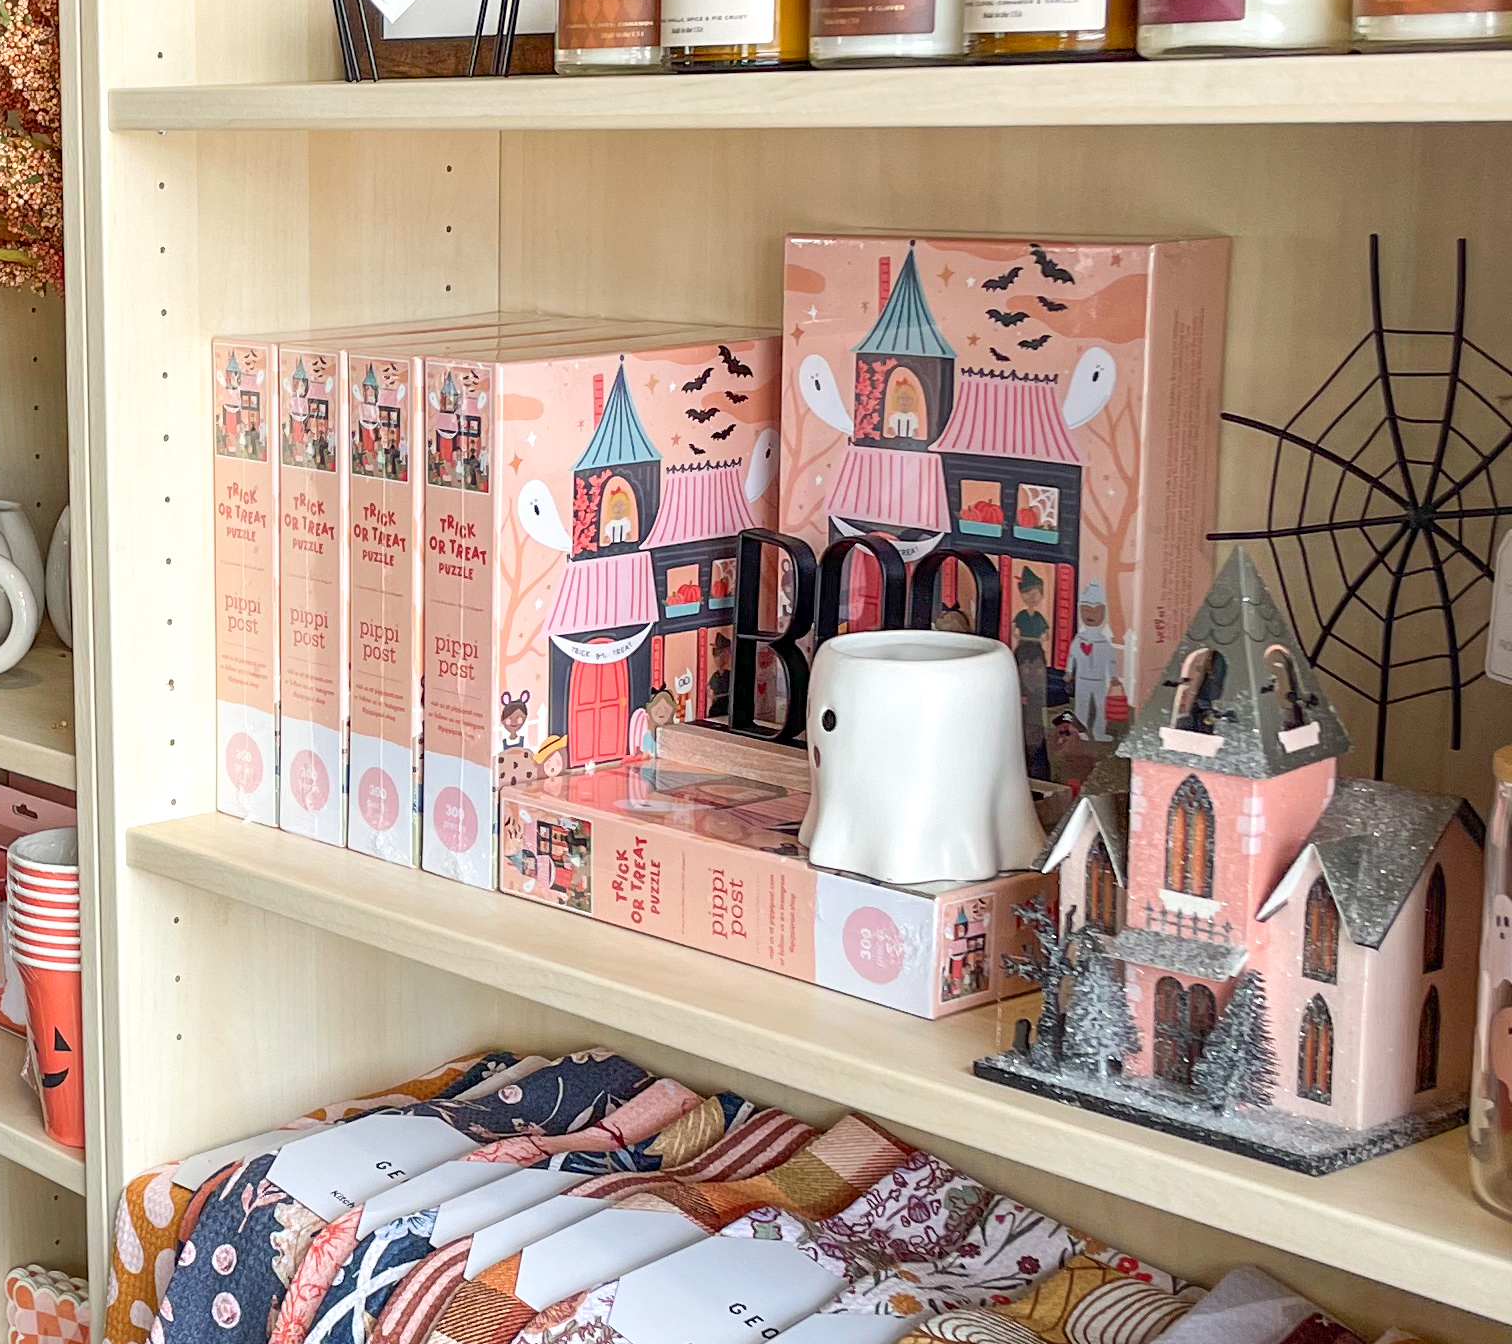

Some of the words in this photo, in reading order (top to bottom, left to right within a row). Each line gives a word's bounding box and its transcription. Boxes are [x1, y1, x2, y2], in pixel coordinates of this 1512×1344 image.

[227, 482, 258, 505] TRICK
[293, 492, 325, 517] TRICK
[218, 502, 232, 520] OR
[234, 506, 267, 529] TREAT
[284, 512, 299, 531] OR
[302, 516, 335, 541] TREAT
[362, 502, 397, 527] TRICK
[440, 513, 476, 539] TRICK
[226, 526, 256, 543] PUZZLE
[292, 537, 324, 555] PUZZLE
[353, 523, 369, 543] OR
[371, 526, 407, 553] TREAT
[362, 549, 395, 567] PUZZLE
[429, 535, 446, 555] OR
[449, 538, 487, 566] TREAT
[438, 562, 474, 581] PUZZLE
[224, 593, 262, 615] pippi
[228, 612, 258, 634] post
[289, 606, 329, 630] pippi
[293, 627, 326, 650] post
[359, 619, 400, 644] pippi
[362, 641, 397, 665] post
[435, 633, 479, 661] pippi
[438, 658, 476, 681] post
[611, 849, 630, 902] TRICK
[630, 835, 648, 891] TREAT
[650, 859, 661, 915] PUZZLE
[631, 898, 645, 924] OR
[708, 867, 728, 940] pippi
[729, 877, 747, 939] post
[860, 928, 872, 960] 300
[330, 1190, 355, 1208] Kitch
